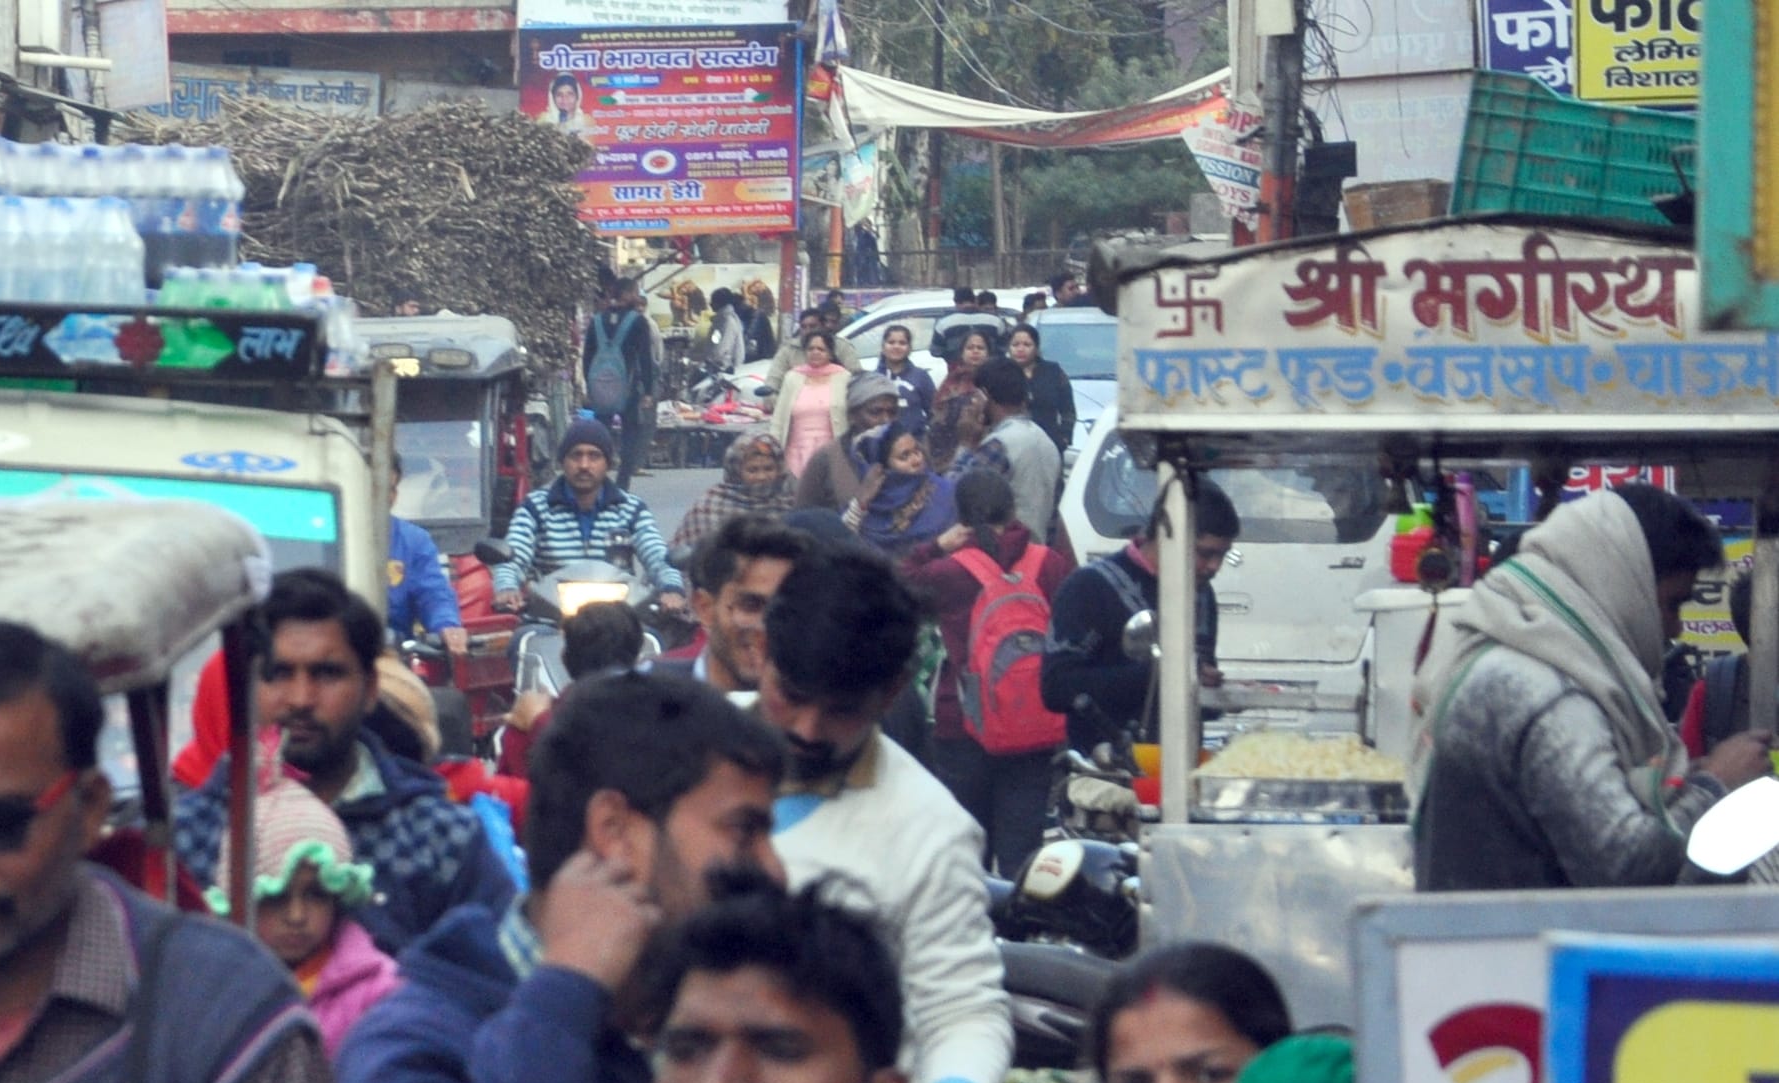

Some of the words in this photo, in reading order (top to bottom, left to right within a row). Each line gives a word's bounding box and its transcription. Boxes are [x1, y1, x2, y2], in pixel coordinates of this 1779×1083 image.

[539, 43, 600, 70] गीता
[603, 48, 694, 70] भागवत
[696, 41, 779, 68] सत्संग
